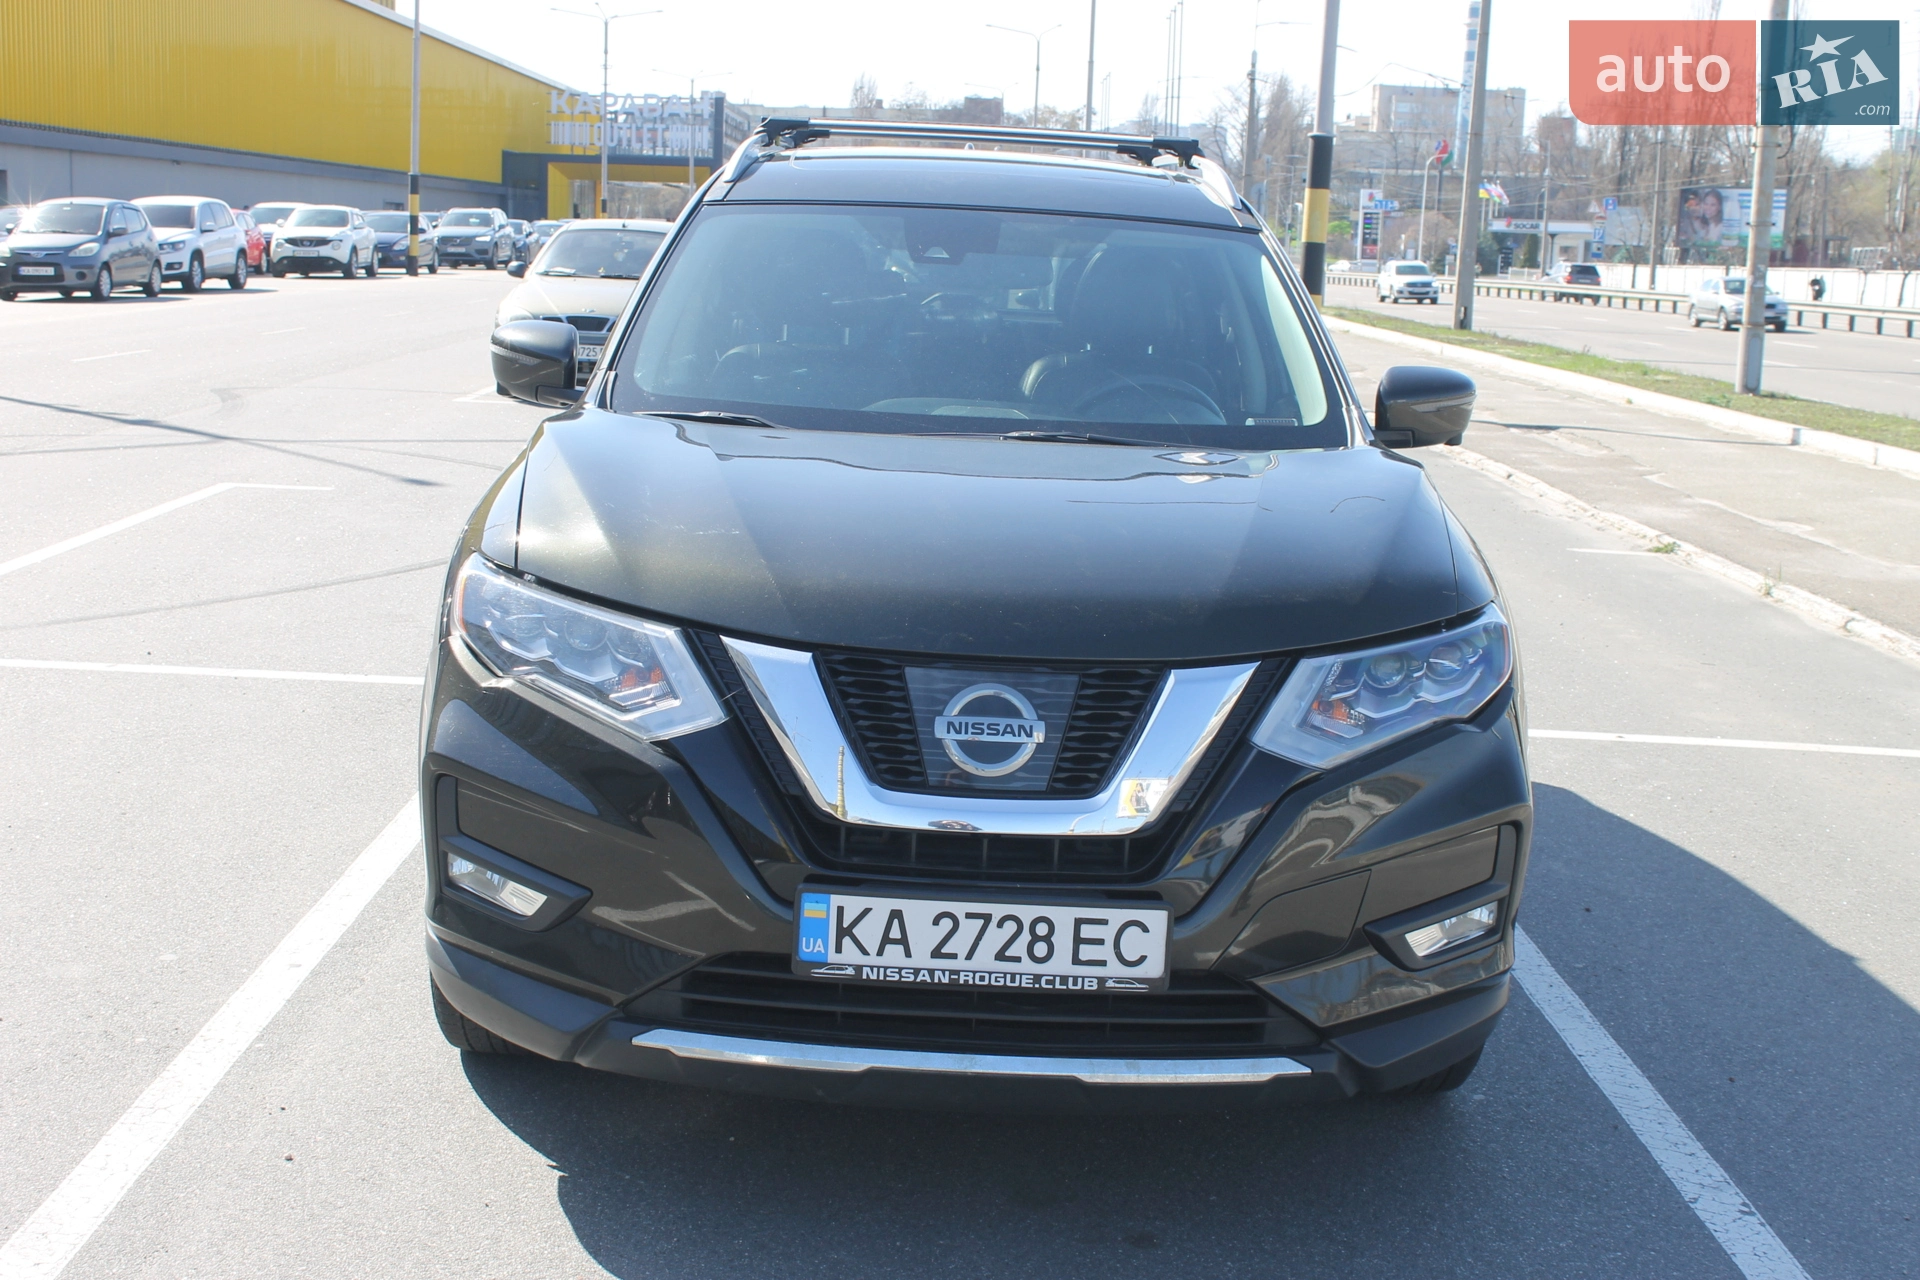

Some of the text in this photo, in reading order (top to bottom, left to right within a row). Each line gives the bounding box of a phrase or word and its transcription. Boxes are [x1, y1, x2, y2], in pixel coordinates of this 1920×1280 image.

[594, 122, 667, 147] OUTLET
[1513, 222, 1541, 230] SOCAR
[578, 347, 597, 357] 725
[946, 720, 1034, 739] NISSAN
[802, 936, 825, 954] UA
[833, 905, 1151, 968] KA 2728 EC
[861, 965, 1098, 991] NISSAN-ROGUE.CLUB
